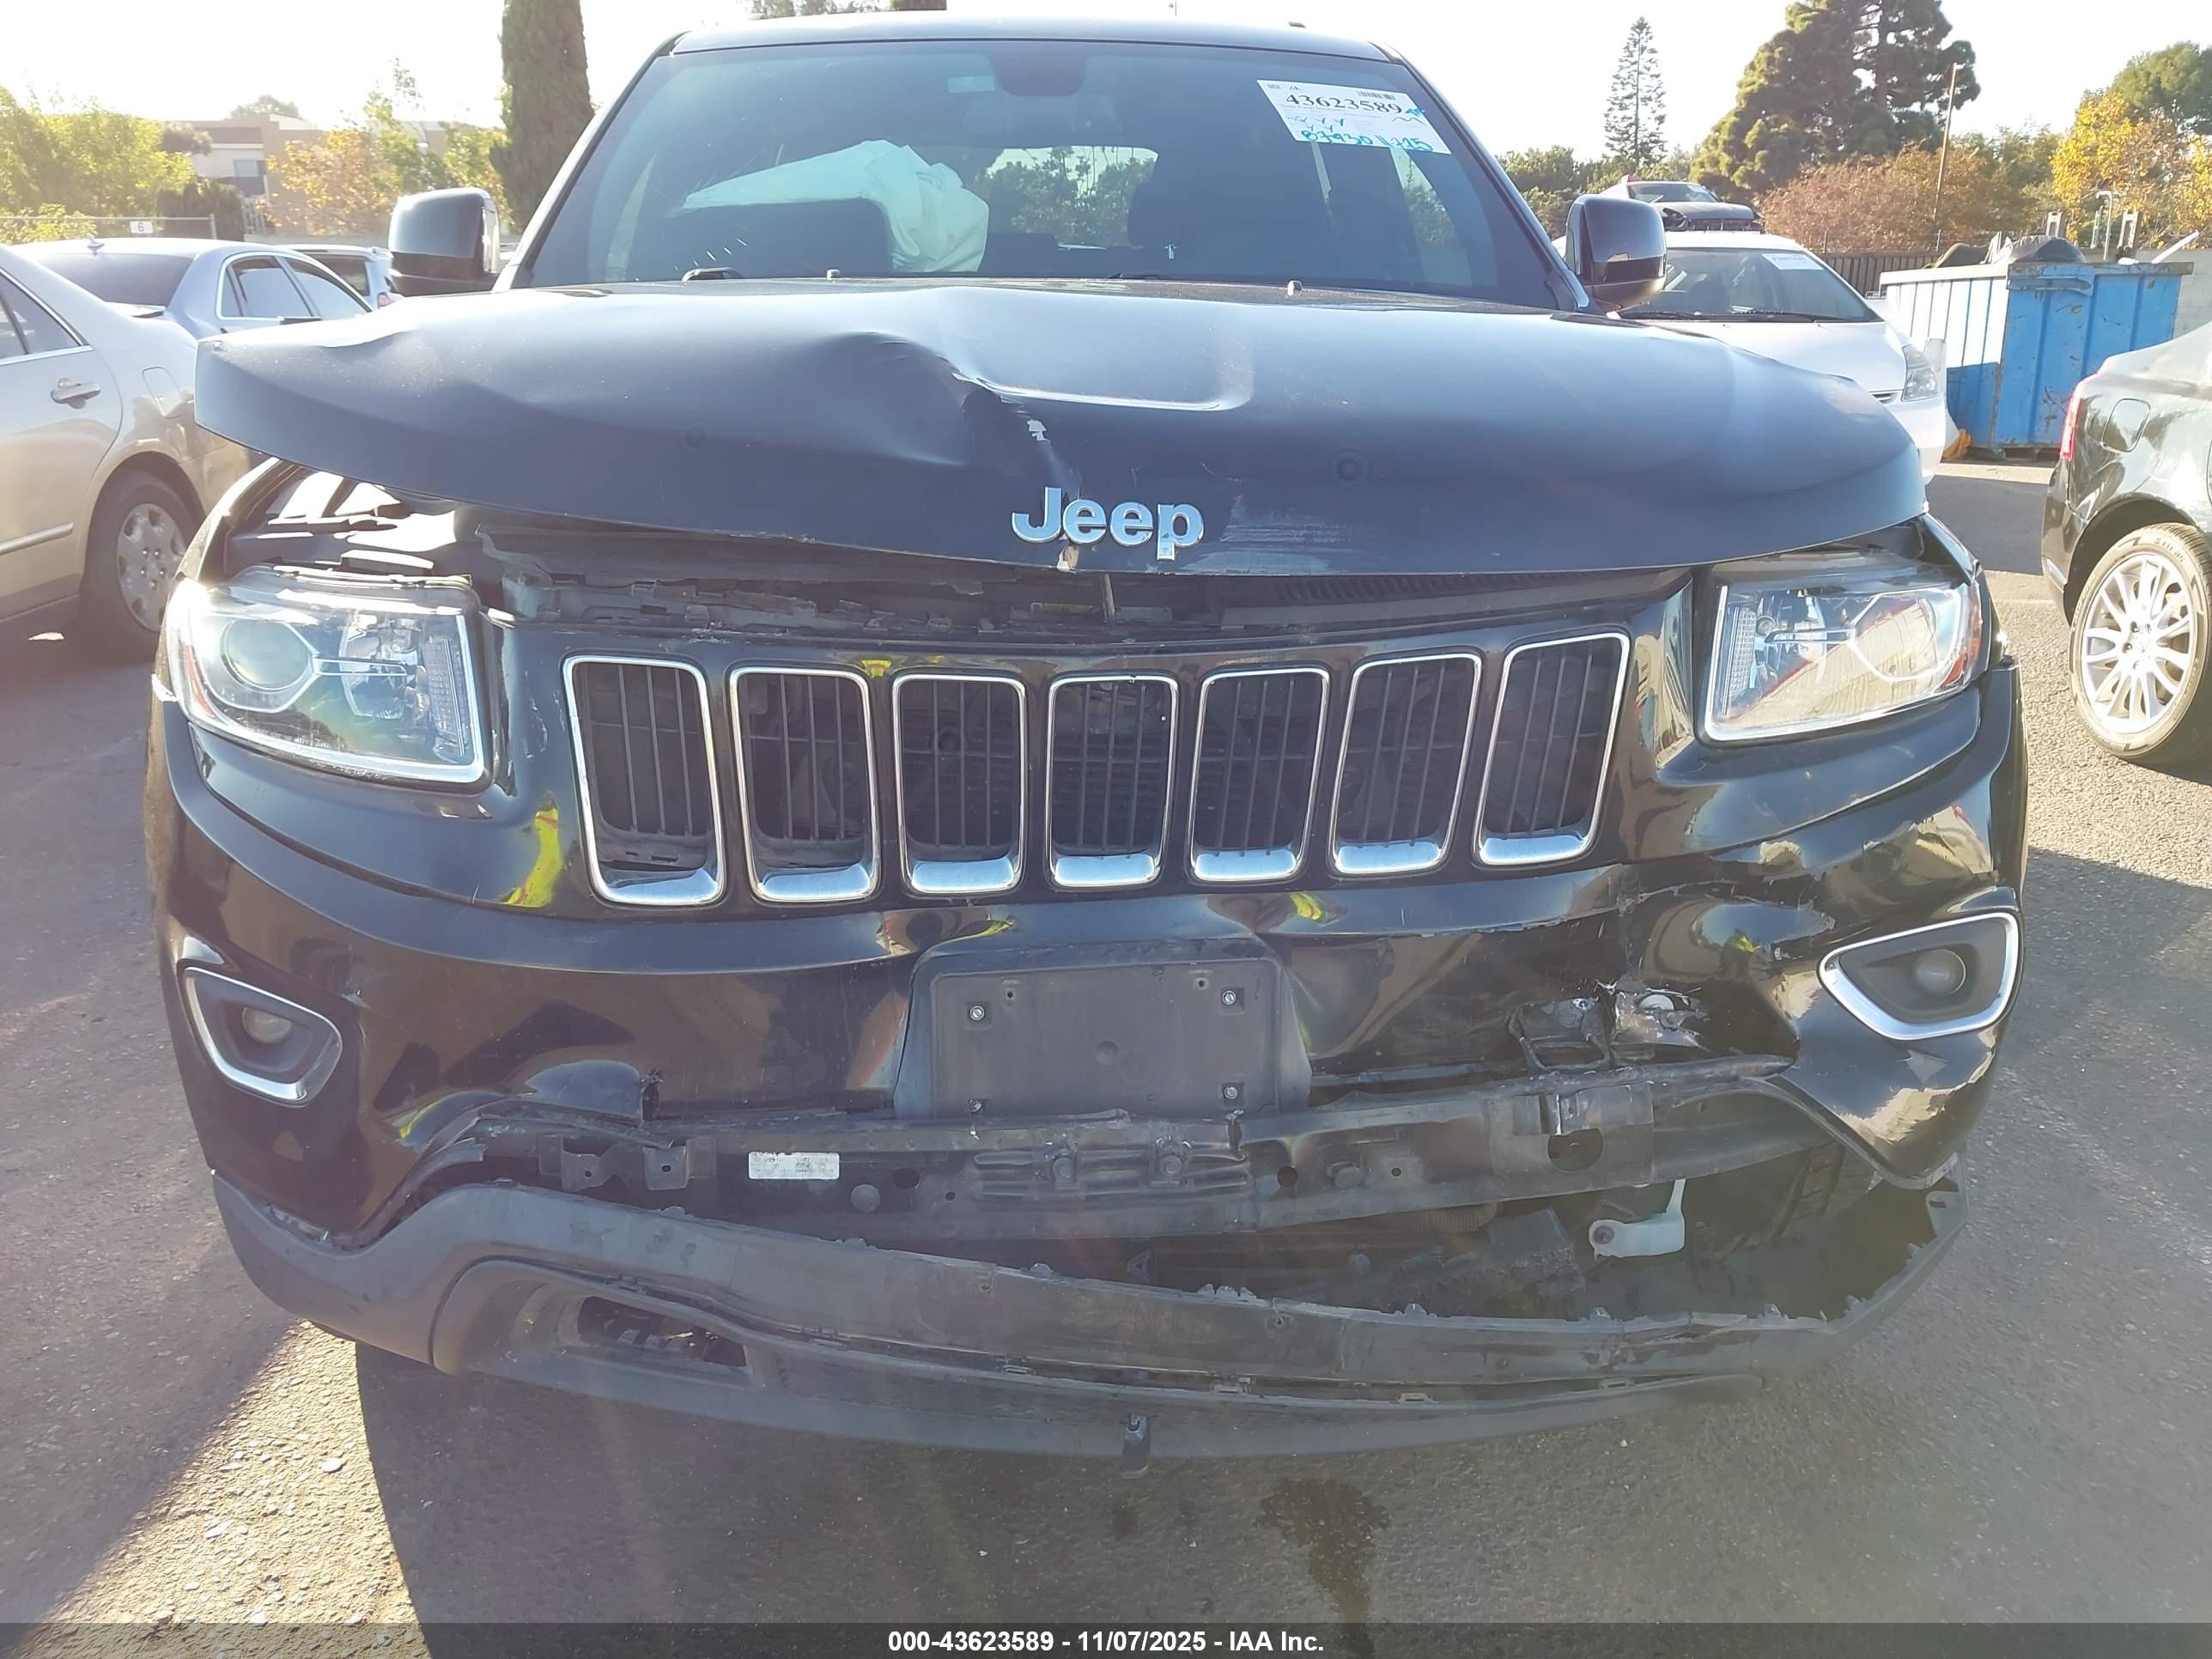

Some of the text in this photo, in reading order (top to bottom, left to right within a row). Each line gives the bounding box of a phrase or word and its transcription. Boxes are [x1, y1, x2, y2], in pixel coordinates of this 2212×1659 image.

[1285, 94, 1402, 113] 43623589
[137, 222, 145, 233] 6
[1012, 486, 1204, 561] Jeep
